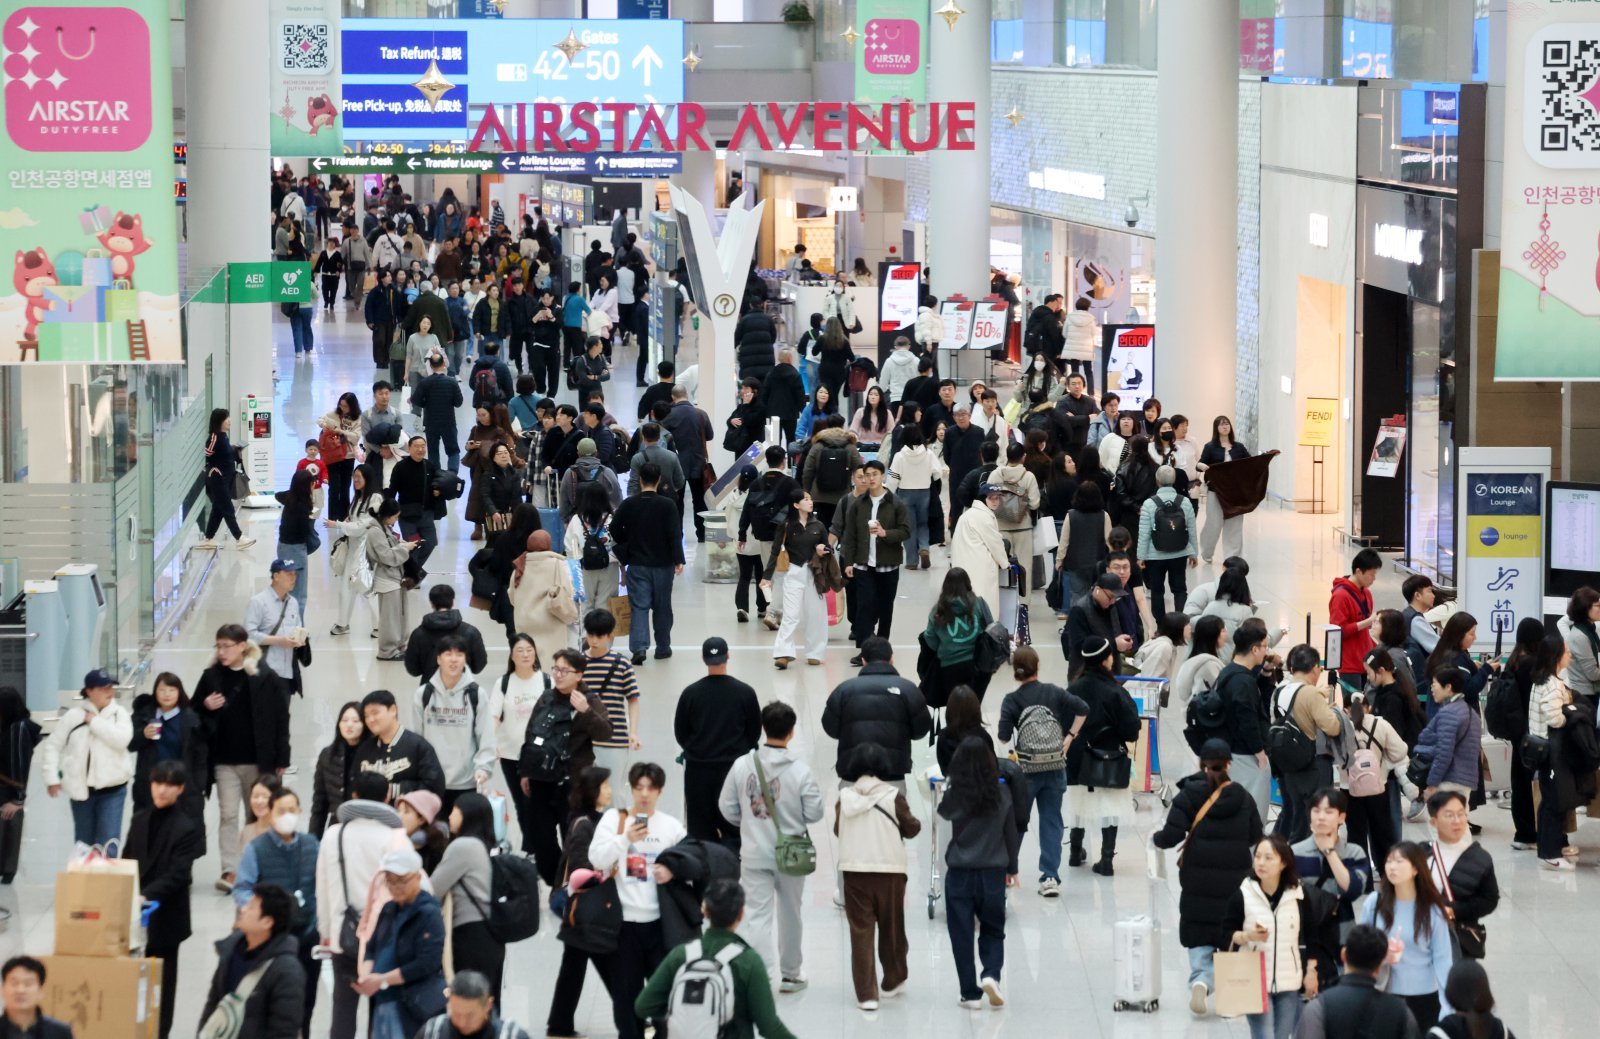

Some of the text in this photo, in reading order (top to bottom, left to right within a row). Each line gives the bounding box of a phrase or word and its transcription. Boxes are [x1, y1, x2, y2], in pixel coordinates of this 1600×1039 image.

[581, 30, 619, 45] Gates
[380, 46, 398, 60] Tax
[400, 46, 440, 61] Refund,
[872, 54, 911, 64] AIRSTAR
[532, 50, 620, 81] 42-50
[28, 100, 130, 122] AIRSTAR
[342, 99, 363, 112] Free
[364, 99, 403, 114] Pick-up,
[40, 126, 119, 134] DUTYFREE
[468, 102, 711, 152] AIRSTAR
[728, 102, 975, 152] AVENUE
[374, 143, 404, 154] 42-50
[331, 155, 393, 166] Transfer Desk
[424, 157, 493, 170] Transfer Lounge
[519, 155, 586, 168] Airline Lounges
[8, 169, 152, 189] 인천공항면세점앱
[1523, 186, 1600, 205] 인천공항
[245, 273, 264, 284] AED
[281, 287, 300, 295] AED
[975, 321, 1002, 339] 50%
[1306, 411, 1333, 421] FENDI
[1490, 485, 1533, 494] KOREAN
[1503, 533, 1528, 541] lounge
